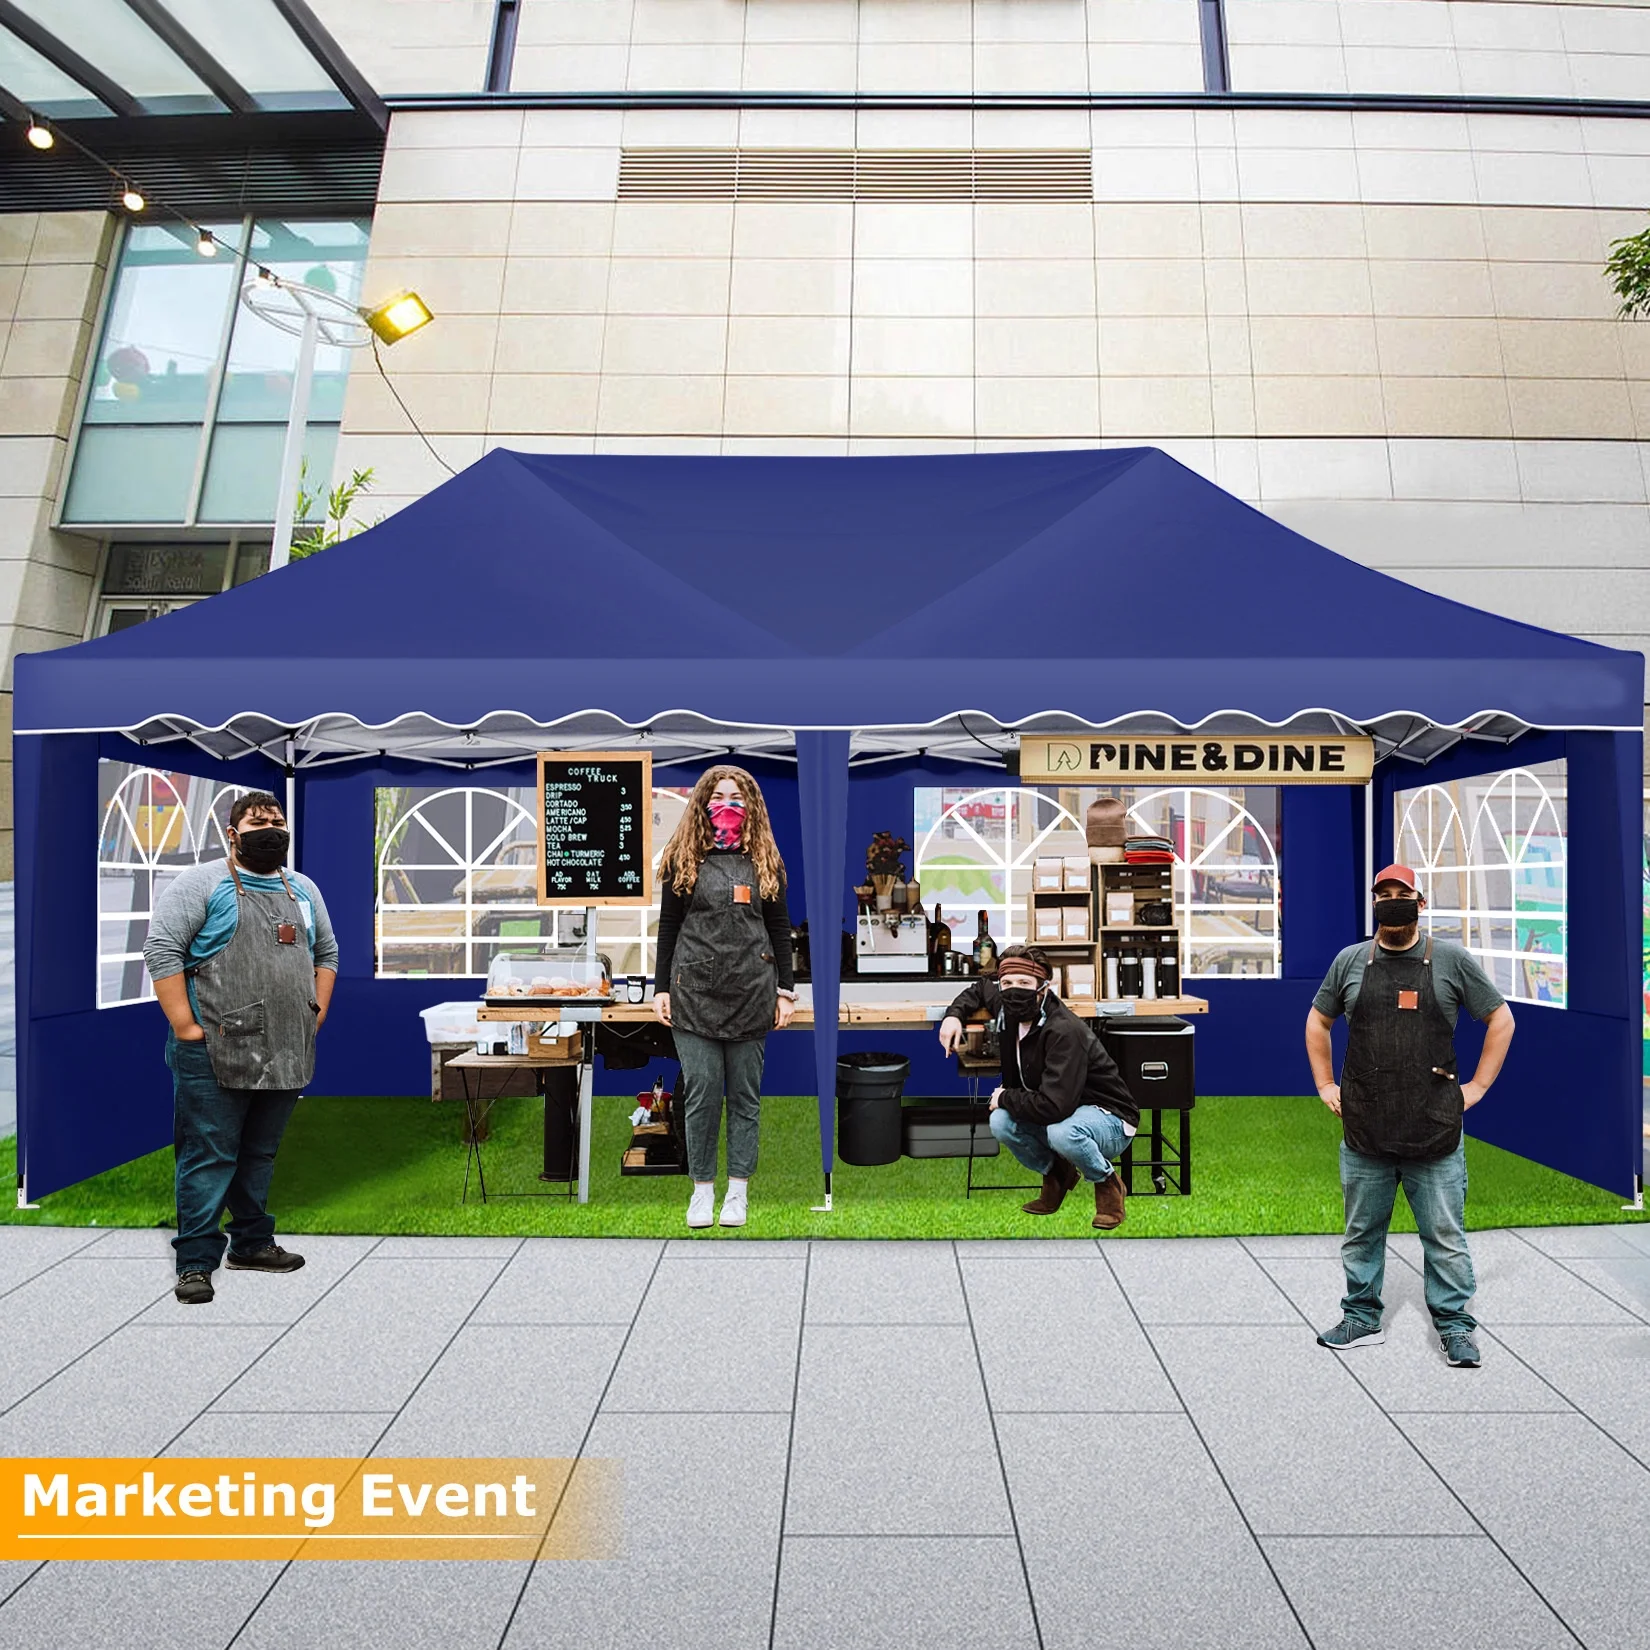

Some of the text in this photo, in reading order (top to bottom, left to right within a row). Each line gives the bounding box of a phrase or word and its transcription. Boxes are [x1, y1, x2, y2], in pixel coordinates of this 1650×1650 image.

[1089, 742, 1347, 773] PINE&DINE
[567, 767, 602, 776] COFFEE
[587, 774, 618, 782] TRUCK
[545, 783, 582, 791] ESPRESSO
[620, 787, 626, 795] 3
[545, 791, 563, 800] DRIP
[545, 800, 578, 808] CORTADO
[545, 808, 586, 816] AMERICANO
[546, 825, 572, 833] MOCHA
[619, 833, 625, 841] 5
[547, 842, 561, 850] TEA
[619, 841, 625, 850] 3
[547, 858, 603, 867] HOT CHOCOLATE
